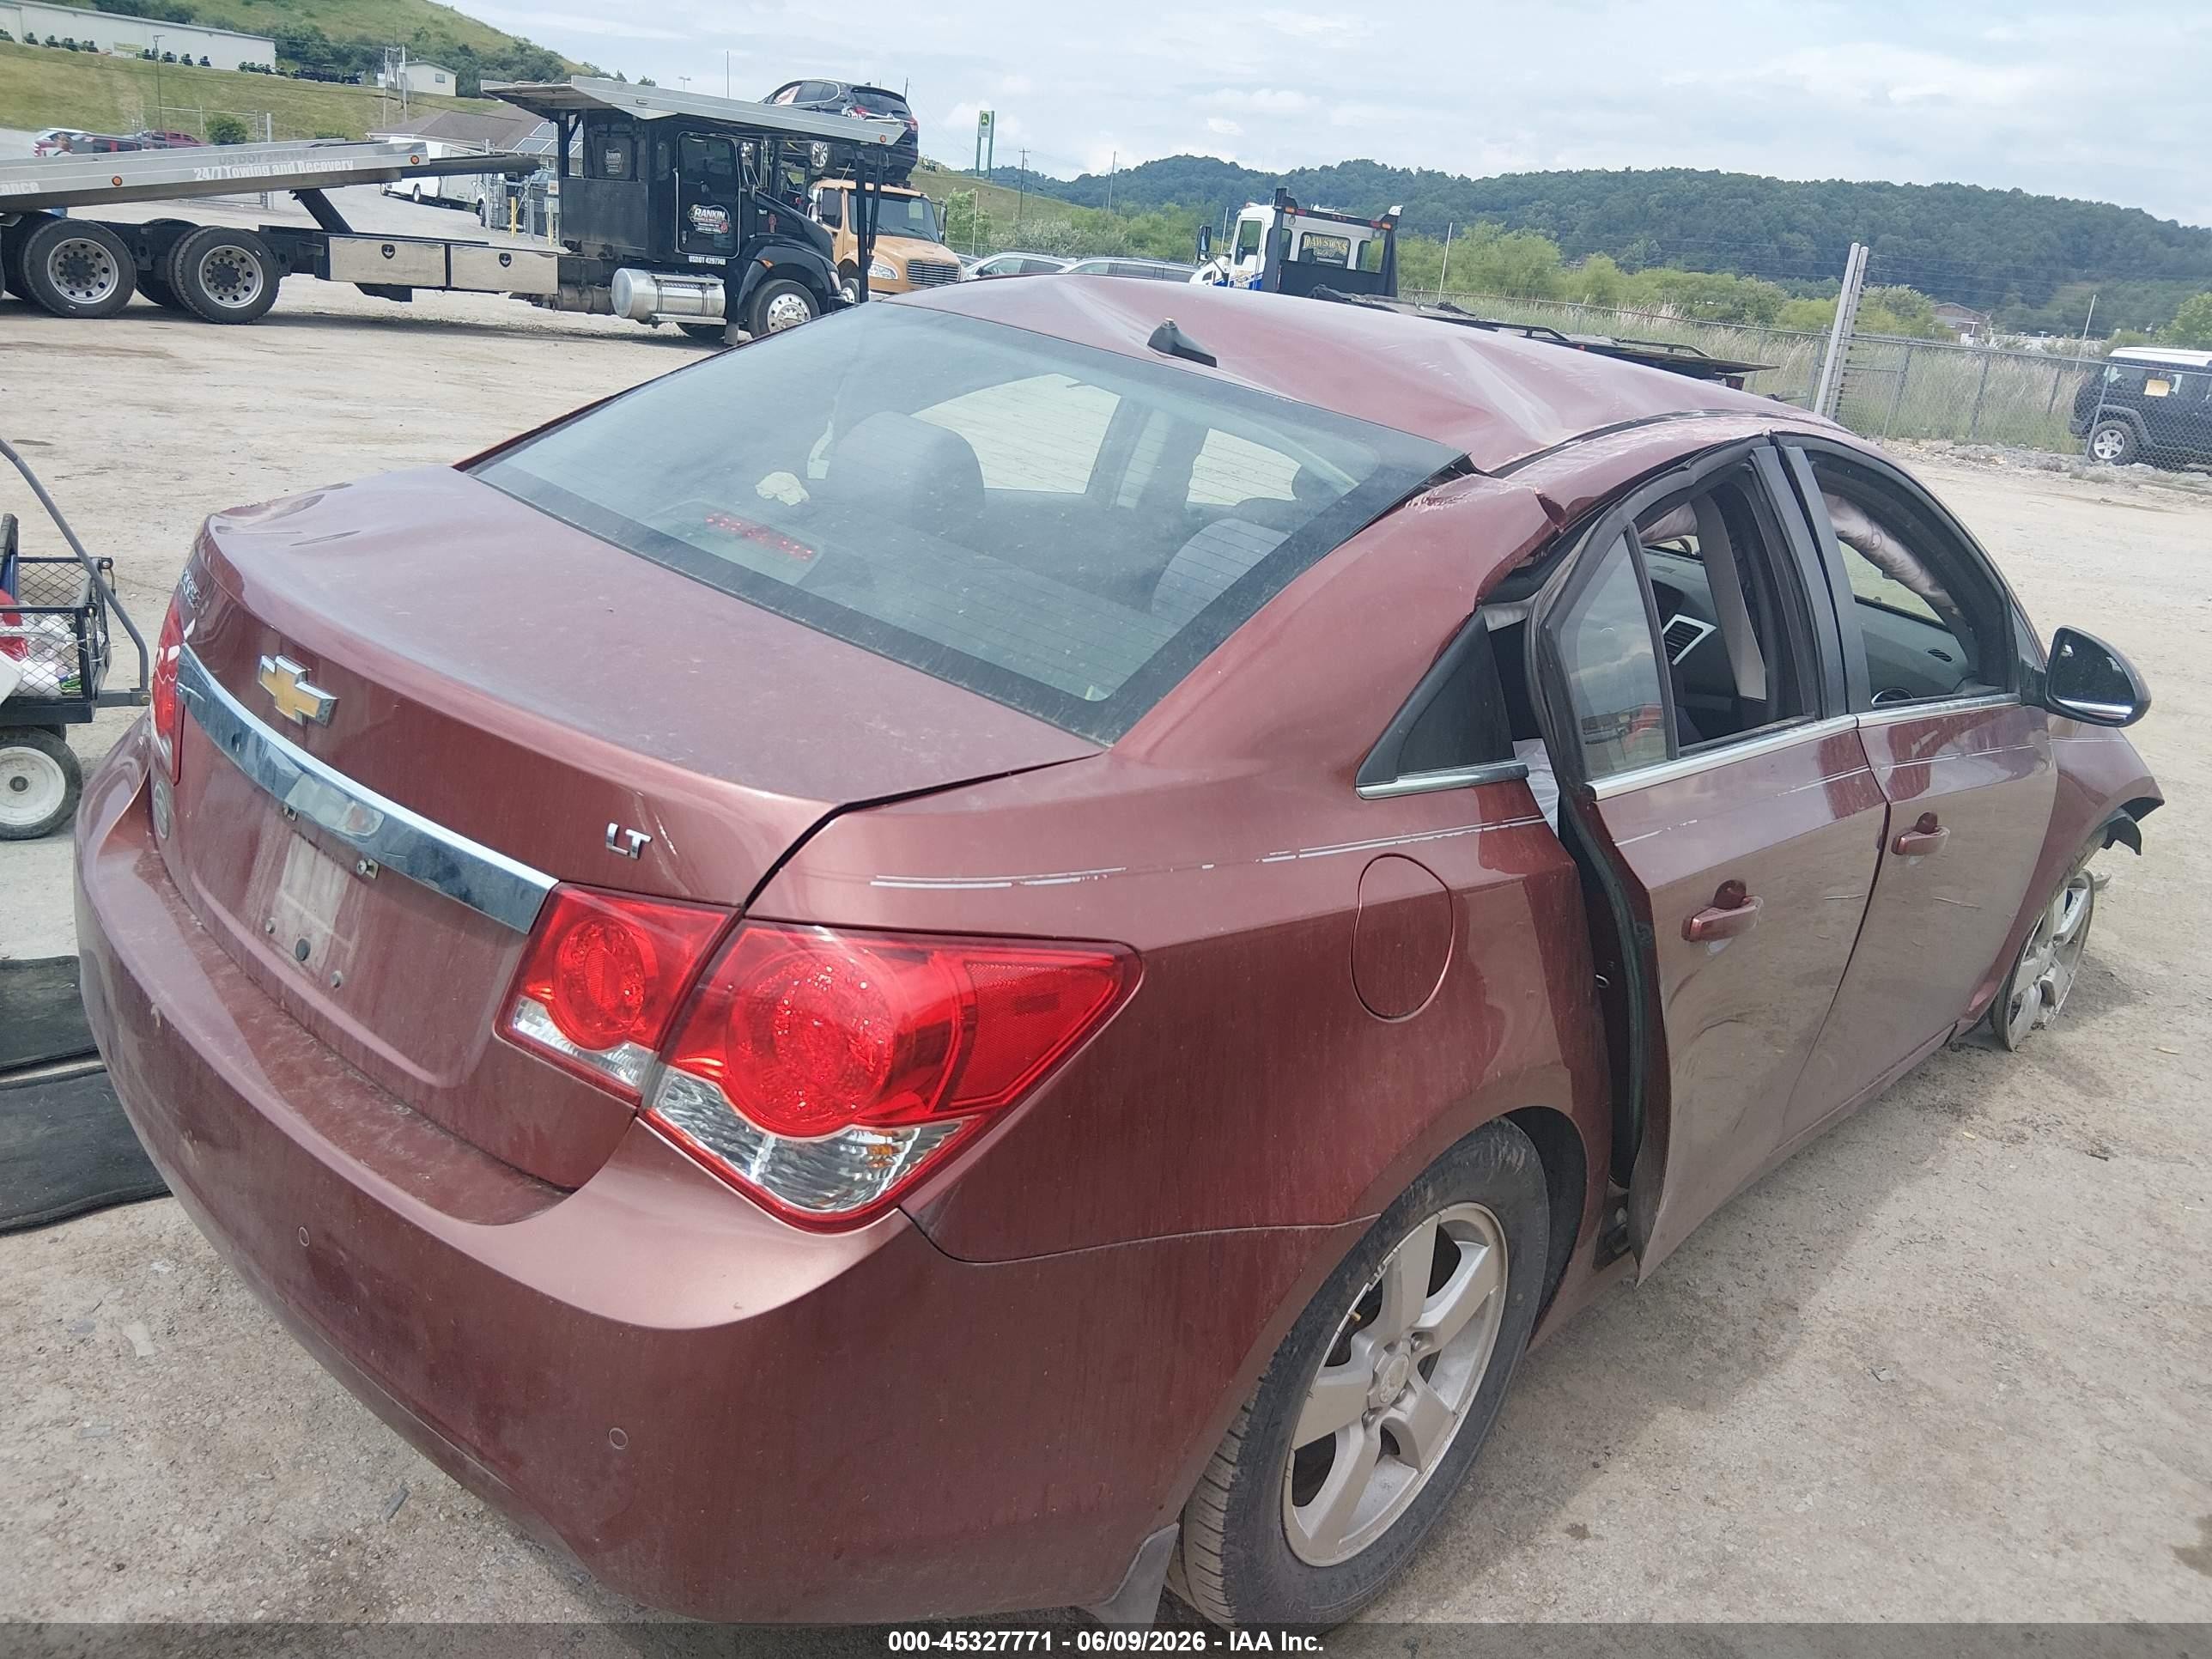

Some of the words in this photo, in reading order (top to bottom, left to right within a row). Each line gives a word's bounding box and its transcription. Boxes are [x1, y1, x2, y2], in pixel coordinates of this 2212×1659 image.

[239, 154, 262, 164] DOT
[194, 167, 222, 180] 24/7
[224, 163, 270, 179] Towing
[271, 161, 295, 176] and
[296, 159, 354, 174] Recovery
[694, 208, 726, 219] RANKIN
[605, 823, 653, 860] LT
